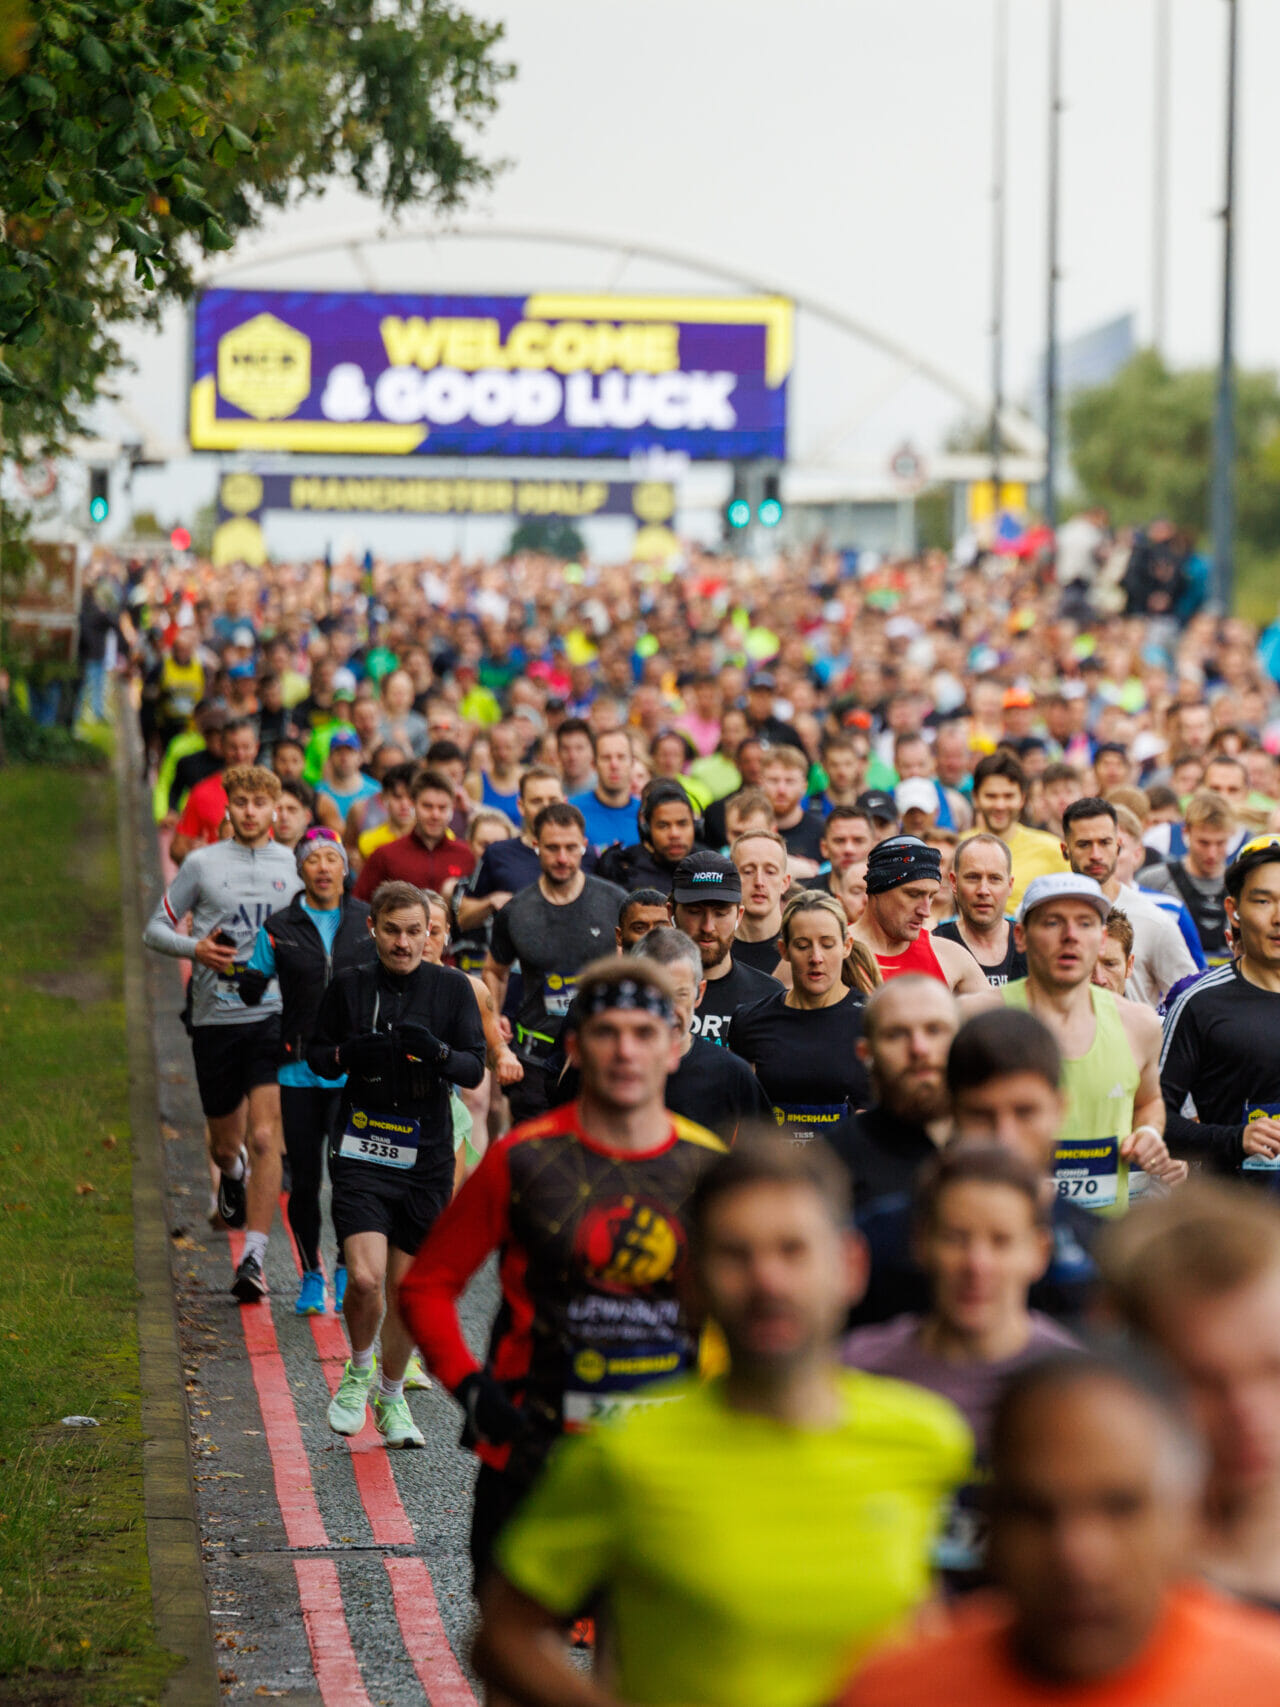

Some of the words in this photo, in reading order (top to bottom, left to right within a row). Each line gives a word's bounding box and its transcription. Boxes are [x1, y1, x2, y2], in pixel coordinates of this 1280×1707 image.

[380, 315, 680, 374] WELCOME
[321, 363, 372, 421] &
[375, 364, 563, 426] GOOD
[564, 369, 738, 430] LUCK
[290, 475, 514, 514] MANCHESTER
[516, 480, 608, 516] HALF
[693, 872, 723, 881] NORTH
[368, 1119, 414, 1134] #MCRHALF
[787, 1113, 840, 1123] #MCRHALF
[358, 1140, 399, 1160] 3238
